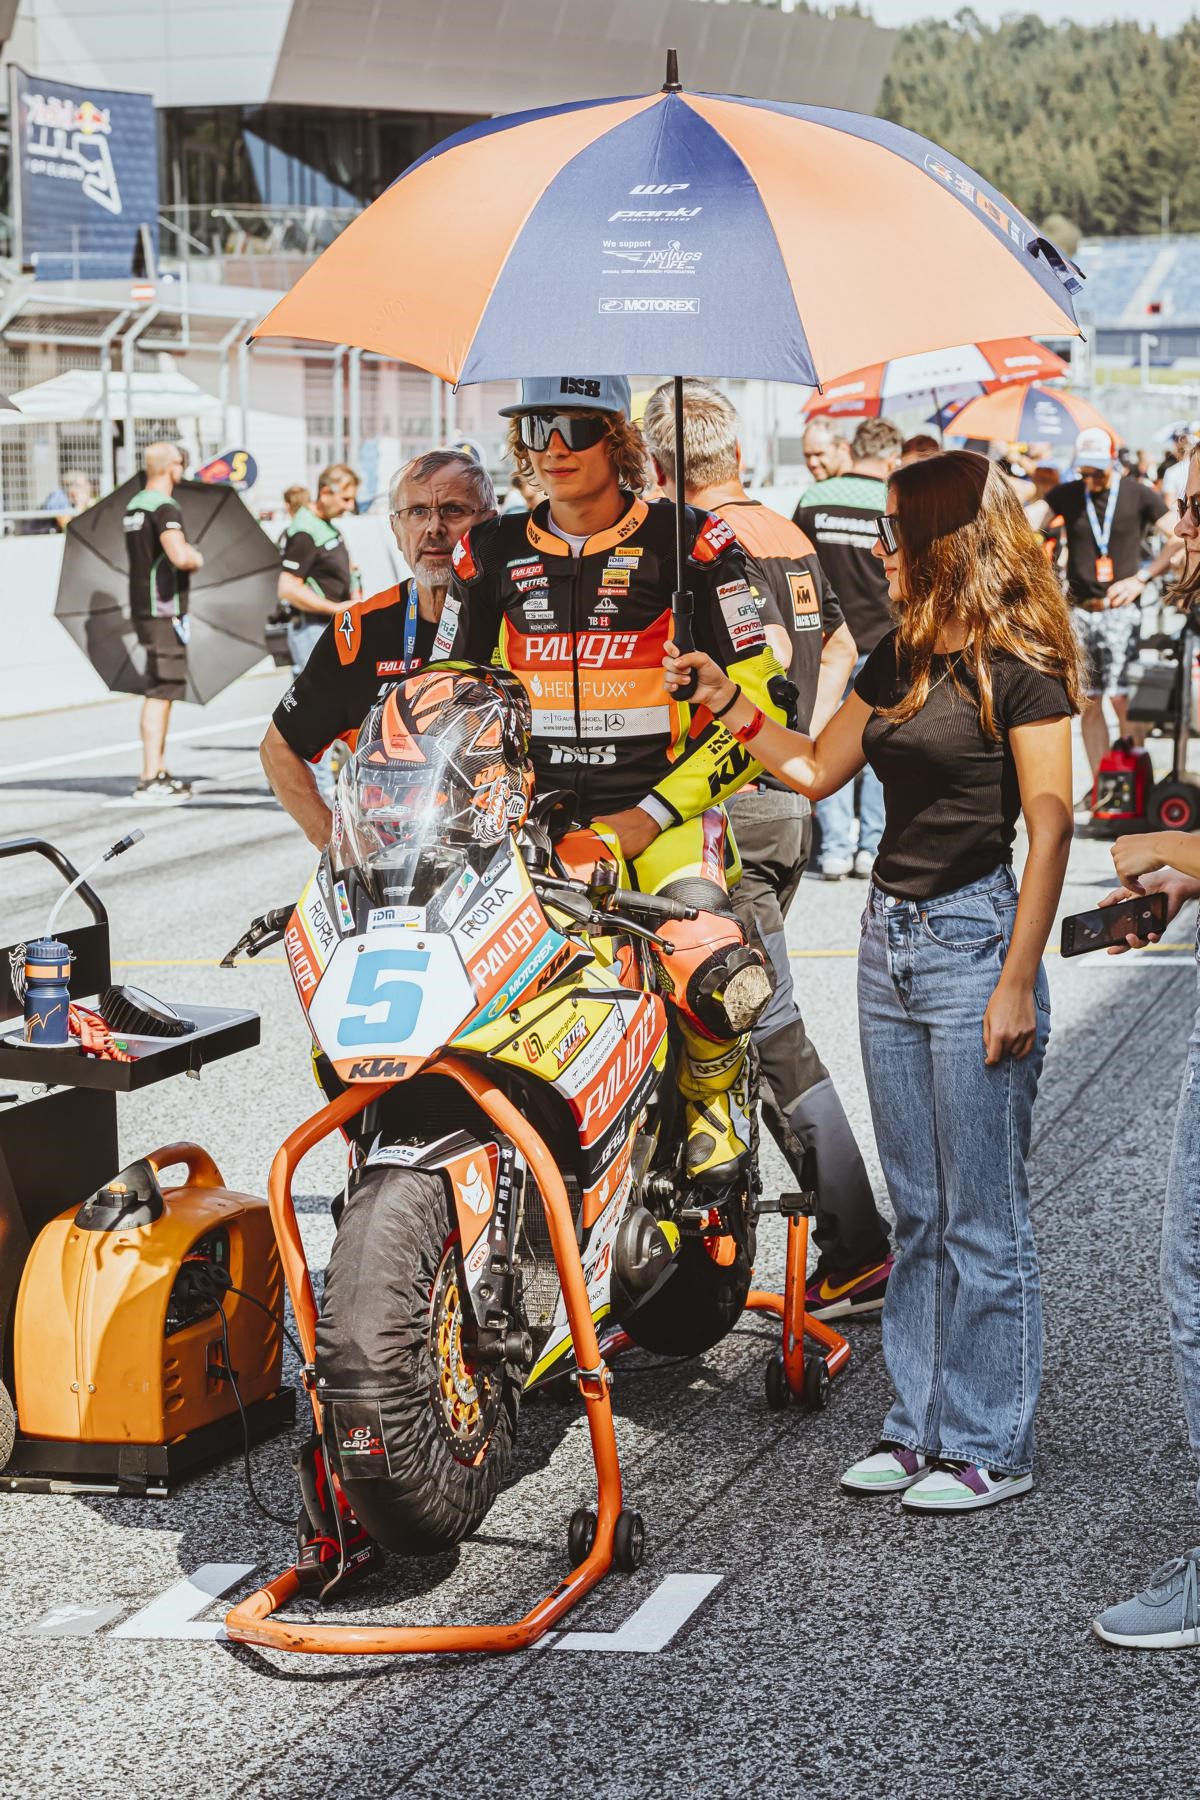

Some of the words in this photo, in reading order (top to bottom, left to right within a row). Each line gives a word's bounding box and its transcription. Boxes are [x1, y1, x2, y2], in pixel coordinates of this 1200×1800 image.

[629, 183, 690, 195] WP
[607, 206, 703, 222] pankl
[602, 239, 616, 248] We
[619, 239, 652, 249] support
[648, 250, 703, 262] WINGS
[658, 260, 687, 270] LIFE
[624, 299, 697, 312] MOTOREX
[229, 451, 249, 482] 5
[515, 577, 549, 592] VETTER
[508, 940, 555, 997] MOTOREX
[336, 948, 432, 1047] 5
[551, 1015, 587, 1064] VETTER
[348, 1058, 407, 1079] KTM
[494, 1148, 513, 1241] PIRELLI
